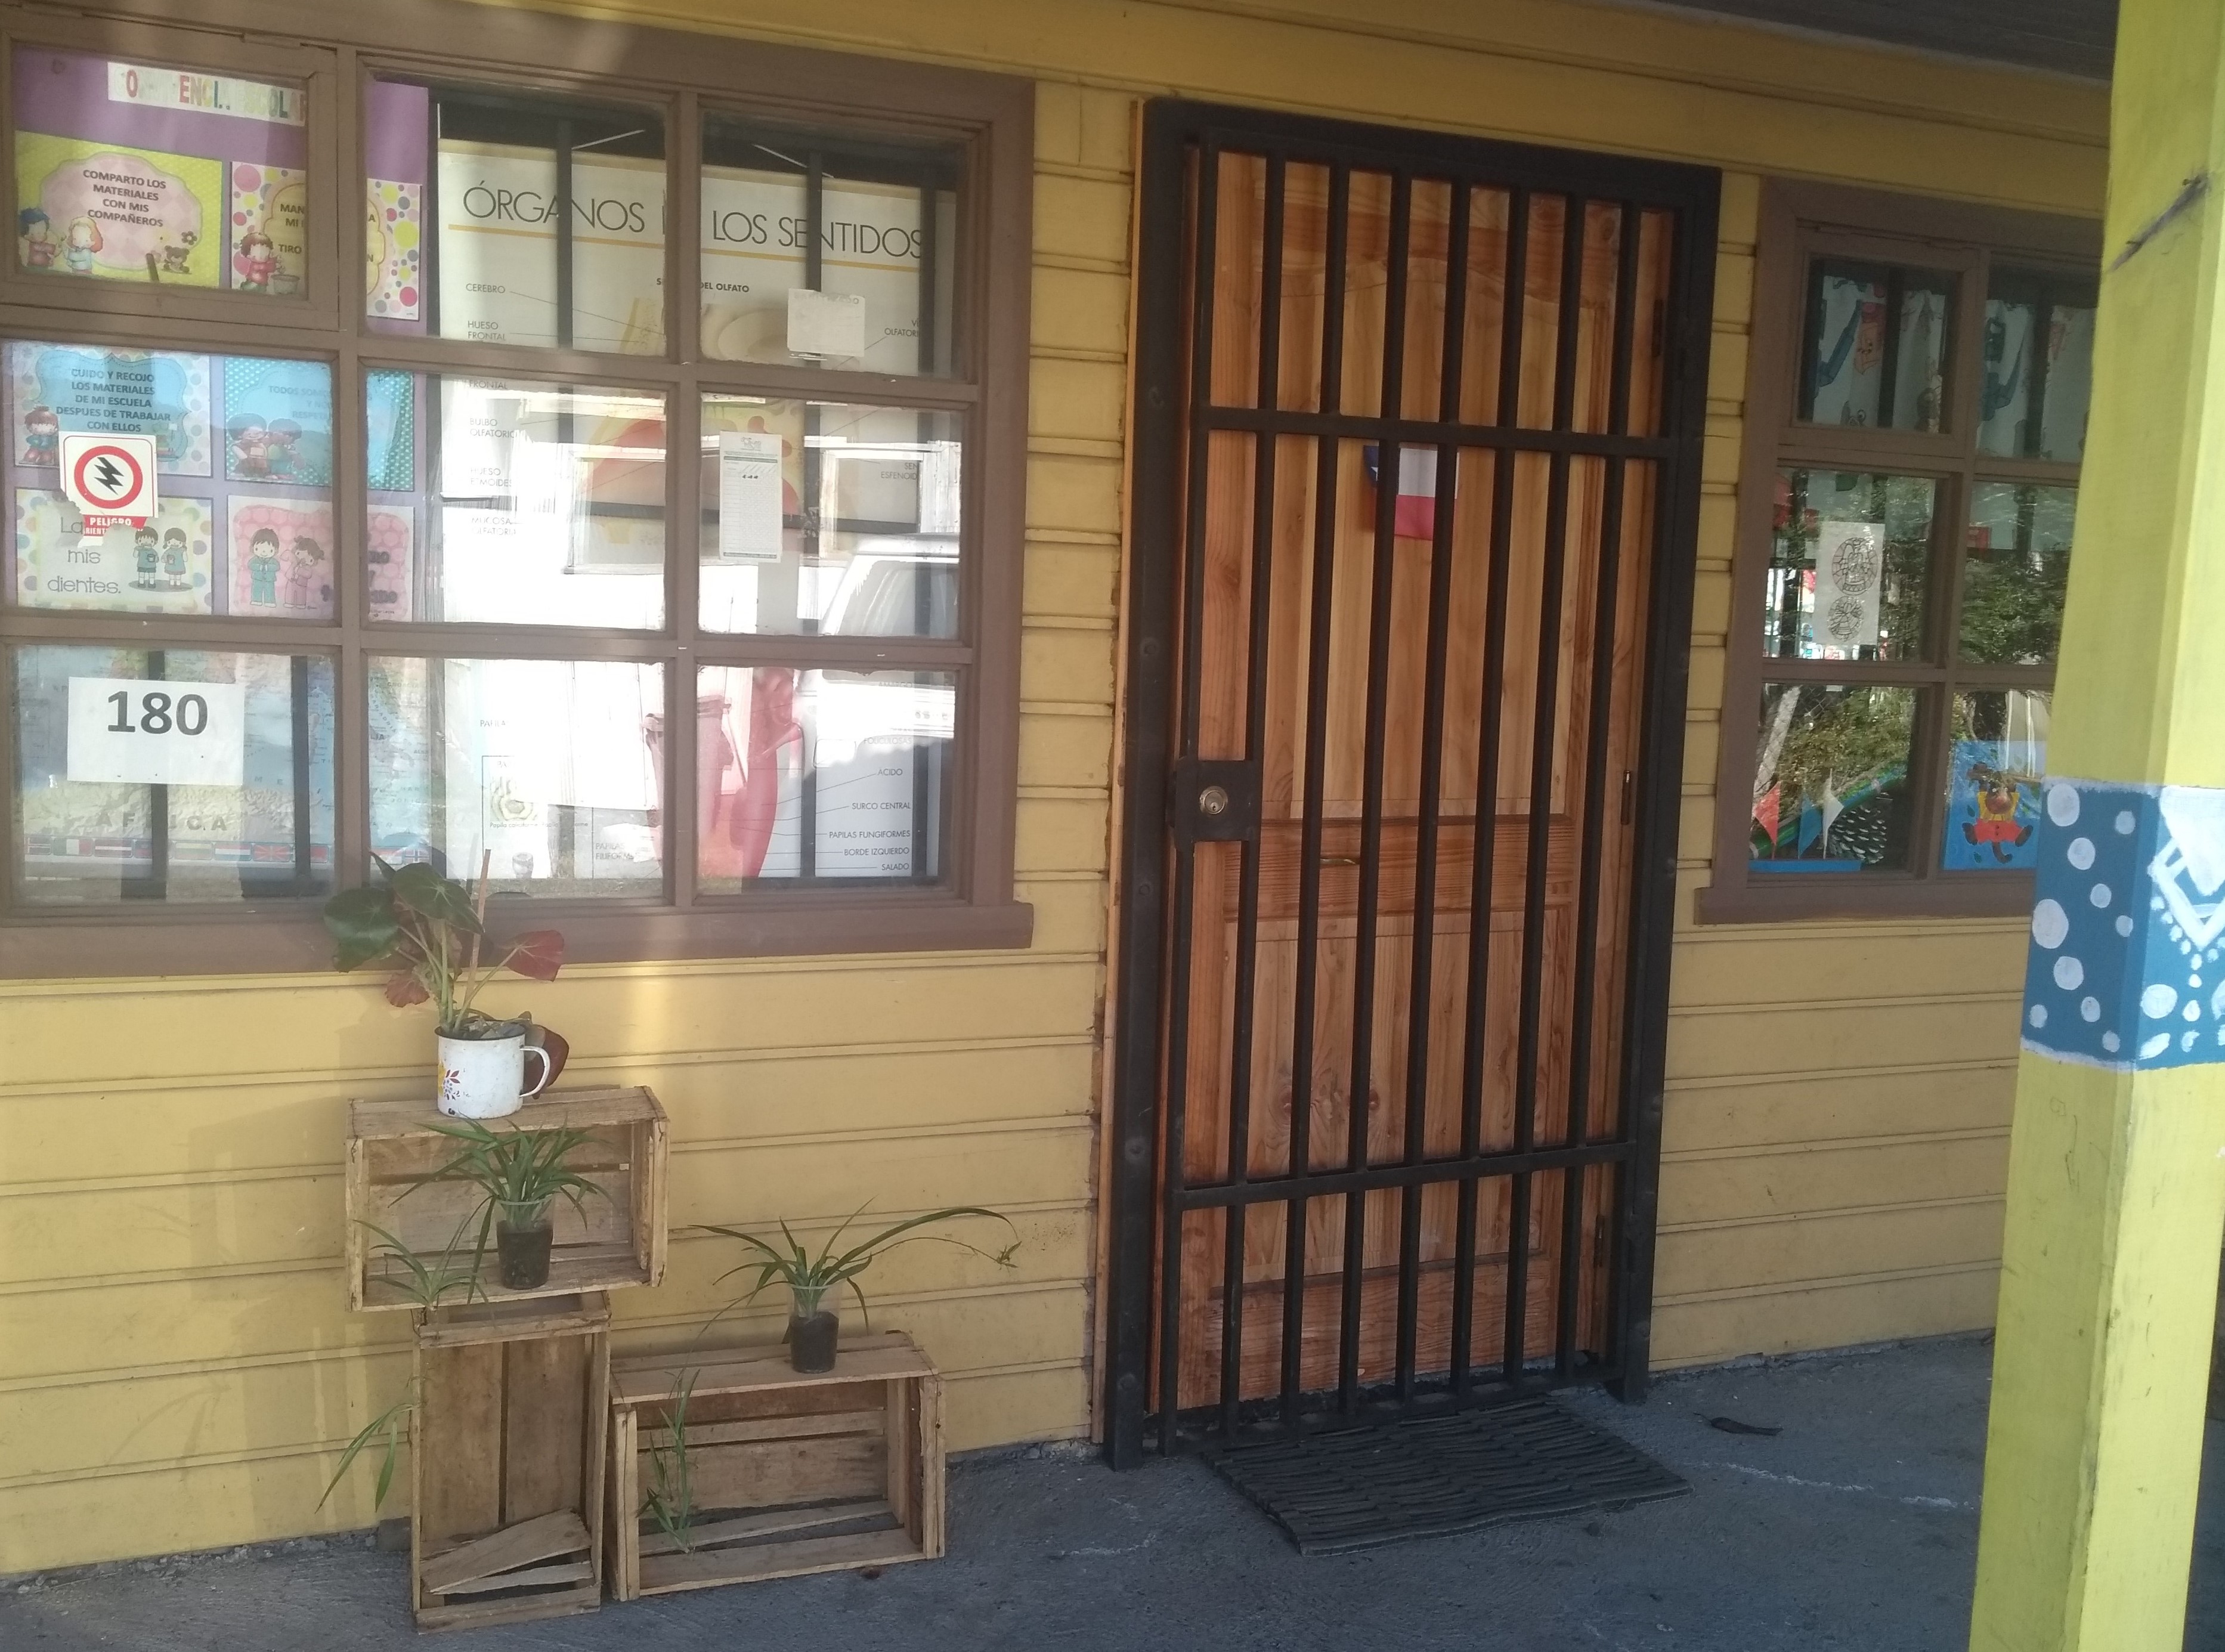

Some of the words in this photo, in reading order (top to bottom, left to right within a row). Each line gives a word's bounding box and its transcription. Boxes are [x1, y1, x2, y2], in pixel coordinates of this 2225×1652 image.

[83, 169, 144, 186] COMPARTO
[147, 179, 166, 189] LOS
[93, 184, 159, 201] MATERIALES
[103, 199, 126, 209] CON
[129, 202, 149, 212] MIS
[463, 180, 645, 233] ÓRGANOS
[88, 209, 163, 227] COMPAÑEROS
[713, 211, 768, 245] LOS
[778, 216, 920, 259] SENTIDOS
[278, 244, 302, 254] TIRO
[466, 283, 506, 293] CEREBRO
[716, 283, 750, 293] OLFATO
[468, 320, 499, 330] HUESO
[468, 332, 506, 341] FRONTAL
[71, 369, 104, 379] CUIDO
[107, 371, 113, 379] Y
[116, 372, 154, 382] RECOJO
[72, 382, 90, 391] LOS
[93, 383, 155, 395] MATERIALES
[75, 395, 88, 404] DE
[91, 396, 105, 405] MI
[108, 397, 152, 408] ESCUELA
[56, 406, 101, 417] DESPUES
[103, 409, 117, 418] DE
[119, 410, 171, 421] TRABAJAR
[88, 421, 109, 431] CON
[112, 422, 141, 432] ELLOS
[470, 418, 497, 426] BULBO
[67, 549, 101, 564] mis
[47, 576, 121, 594] dientes.
[107, 690, 208, 736] 180
[95, 812, 228, 831] AFICA
[859, 830, 911, 839] FUNGIFORMES
[871, 847, 909, 855] IZQUIERDO
[881, 862, 909, 871] SALADO
